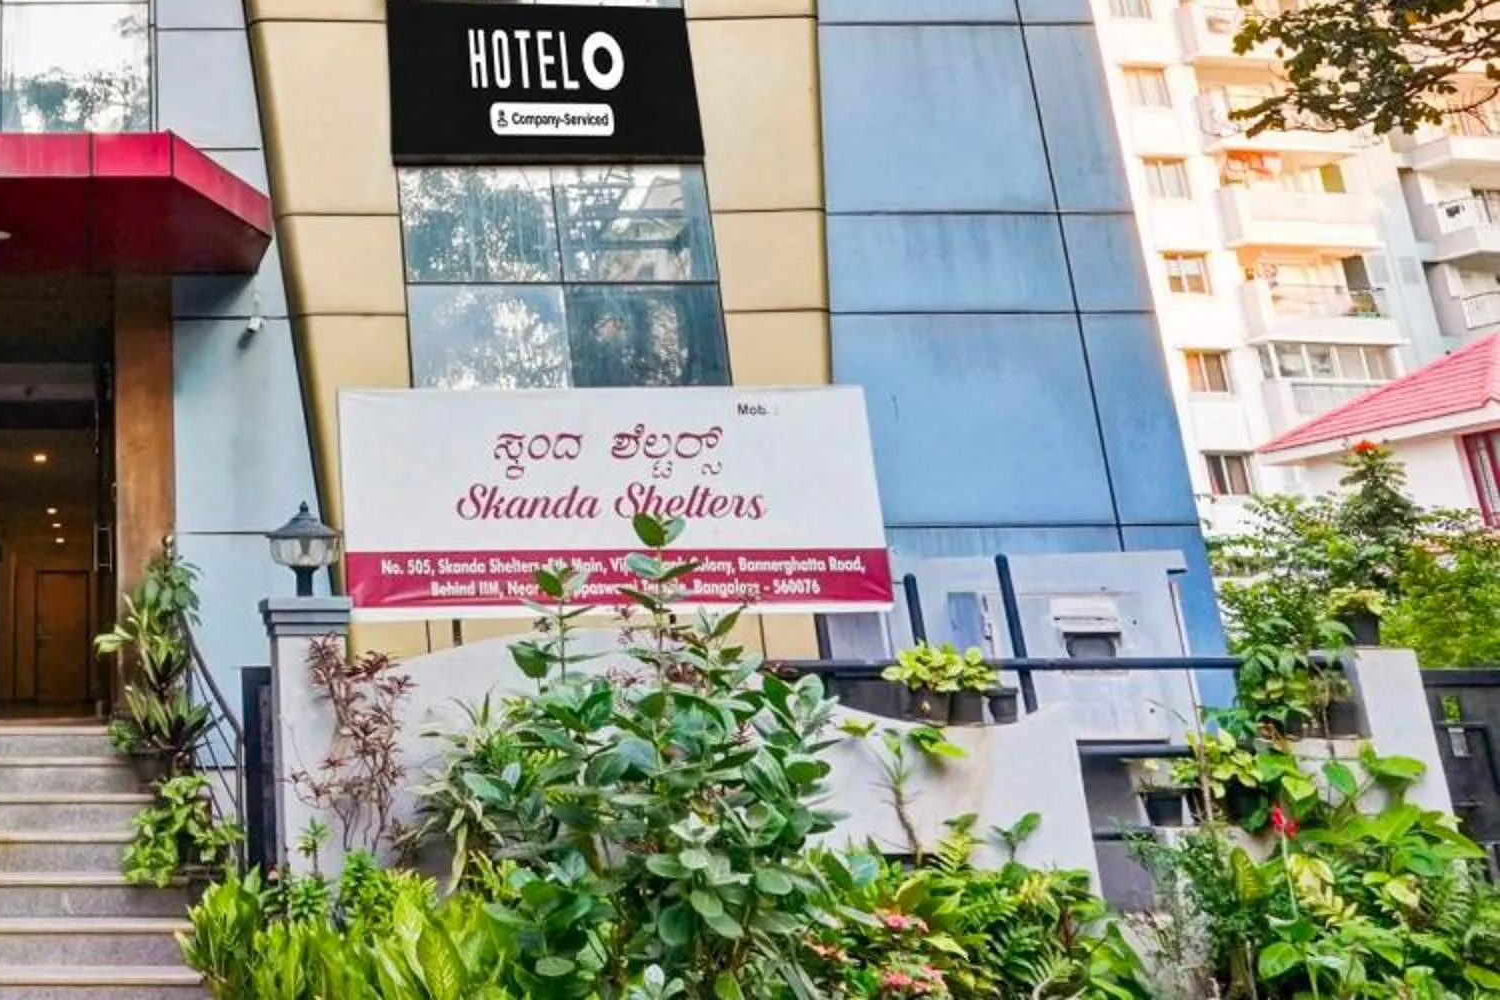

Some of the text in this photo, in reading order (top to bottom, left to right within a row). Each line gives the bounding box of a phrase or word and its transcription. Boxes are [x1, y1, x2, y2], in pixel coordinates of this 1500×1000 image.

[511, 110, 609, 128] Company-Serviced
[493, 432, 583, 480] ಸ್ಕಂದ
[456, 481, 765, 520] Skanda Shelters
[381, 558, 404, 575] No.
[407, 558, 435, 577] 505,
[437, 557, 486, 574] Skanda
[737, 556, 826, 576] Bannerghatta
[828, 555, 866, 574] Road,
[431, 580, 476, 597] Behind
[772, 578, 820, 596] 560076
